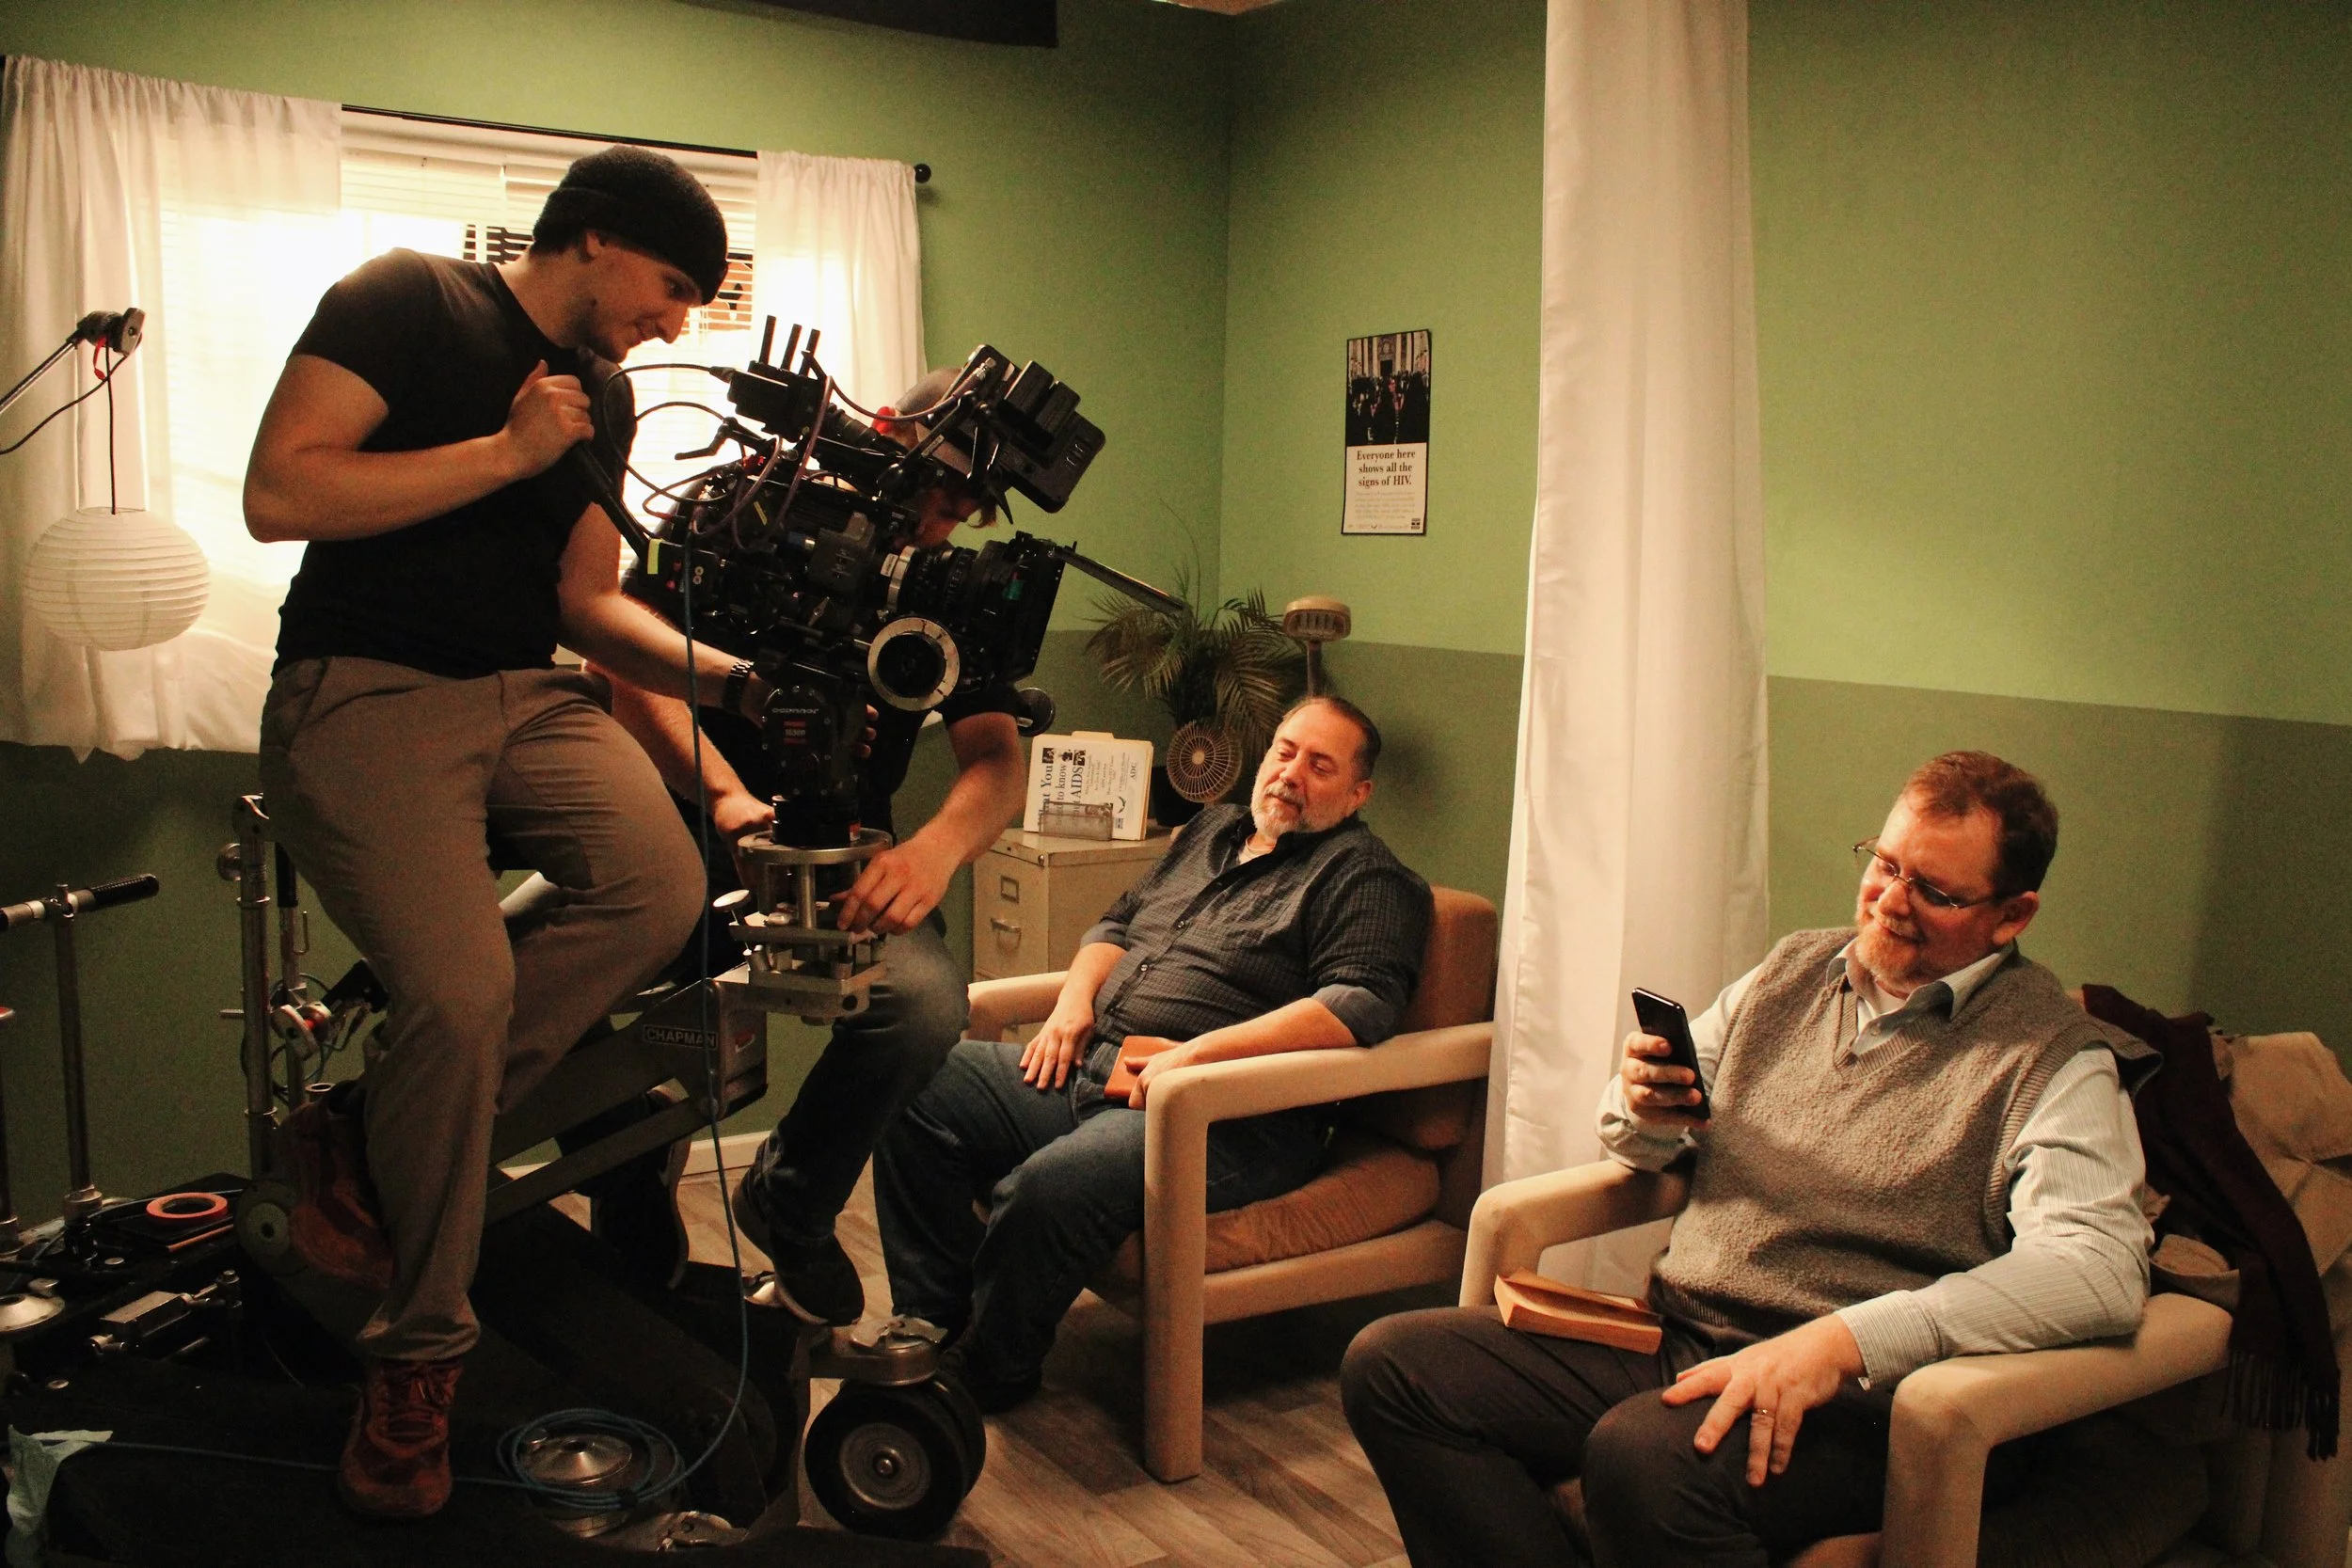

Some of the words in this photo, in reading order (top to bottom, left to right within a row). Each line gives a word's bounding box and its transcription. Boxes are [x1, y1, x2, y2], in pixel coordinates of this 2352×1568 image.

[1357, 450, 1395, 464] Everyone
[1396, 449, 1416, 459] here
[1359, 463, 1384, 473] shows
[1386, 462, 1397, 472] all
[1399, 462, 1413, 472] the
[1359, 476, 1379, 489] signs
[1381, 476, 1391, 486] of
[1393, 475, 1412, 486] HIV.
[1041, 766, 1053, 788] You
[1055, 764, 1067, 789] know
[1071, 766, 1084, 799] AIDS
[1057, 791, 1065, 800] to
[646, 1028, 715, 1047] CHAPMAN
